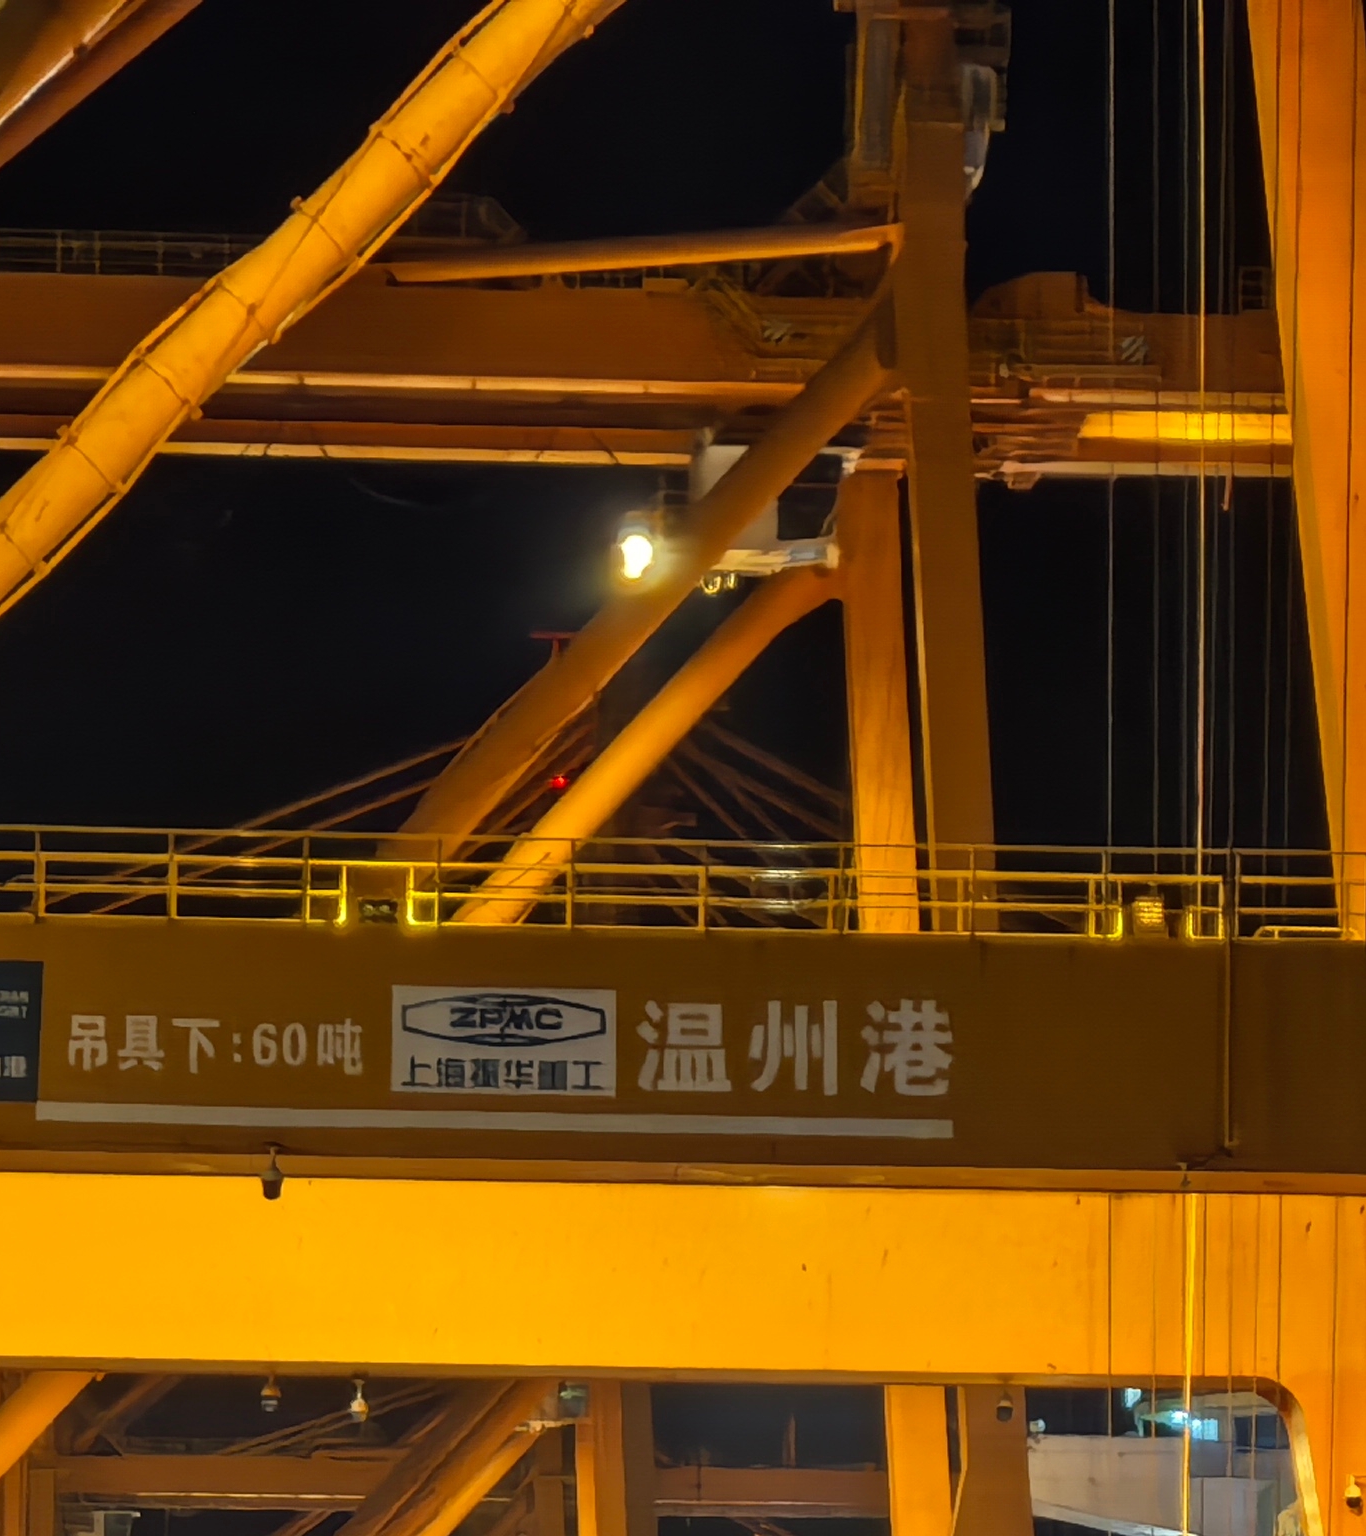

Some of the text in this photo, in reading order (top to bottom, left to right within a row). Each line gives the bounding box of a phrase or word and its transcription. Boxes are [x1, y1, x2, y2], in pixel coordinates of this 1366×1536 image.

[448, 1006, 563, 1031] ZPMC
[636, 998, 954, 1097] 温州港
